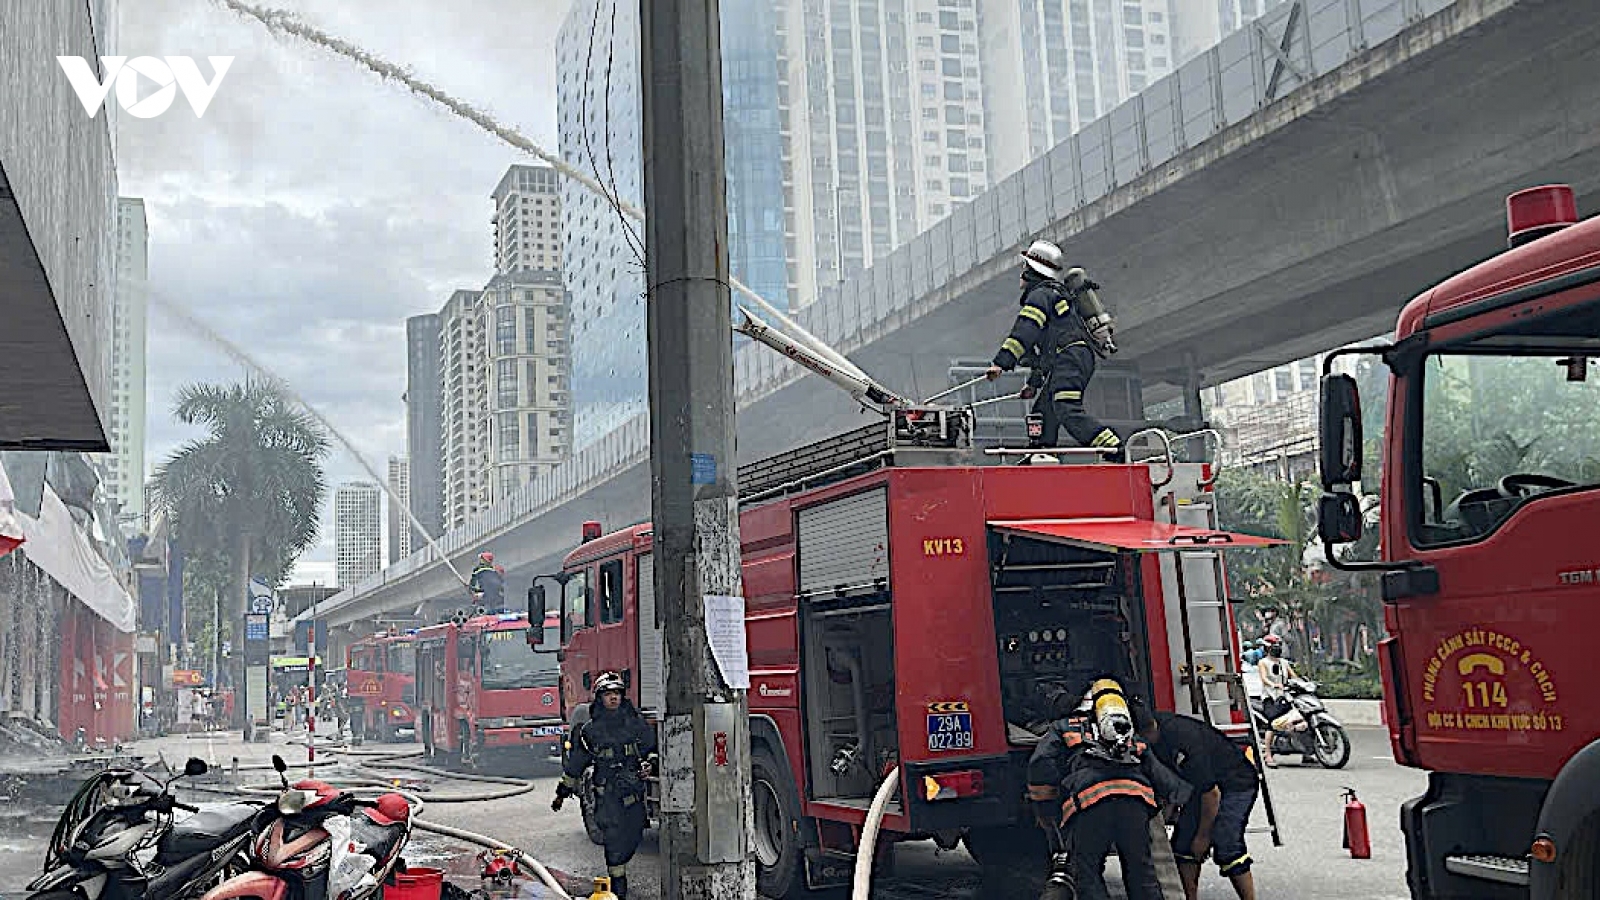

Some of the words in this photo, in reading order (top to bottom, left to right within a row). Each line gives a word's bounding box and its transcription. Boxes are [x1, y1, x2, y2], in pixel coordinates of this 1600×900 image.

[923, 538, 963, 555] KV13
[1559, 570, 1592, 584] TGM
[1464, 626, 1486, 646] SÁT
[1488, 631, 1520, 656] PCCC
[1520, 649, 1531, 664] &
[1530, 661, 1557, 702] CNCH
[1462, 681, 1507, 707] 114
[937, 715, 962, 732] 29A
[1547, 715, 1562, 731] 13
